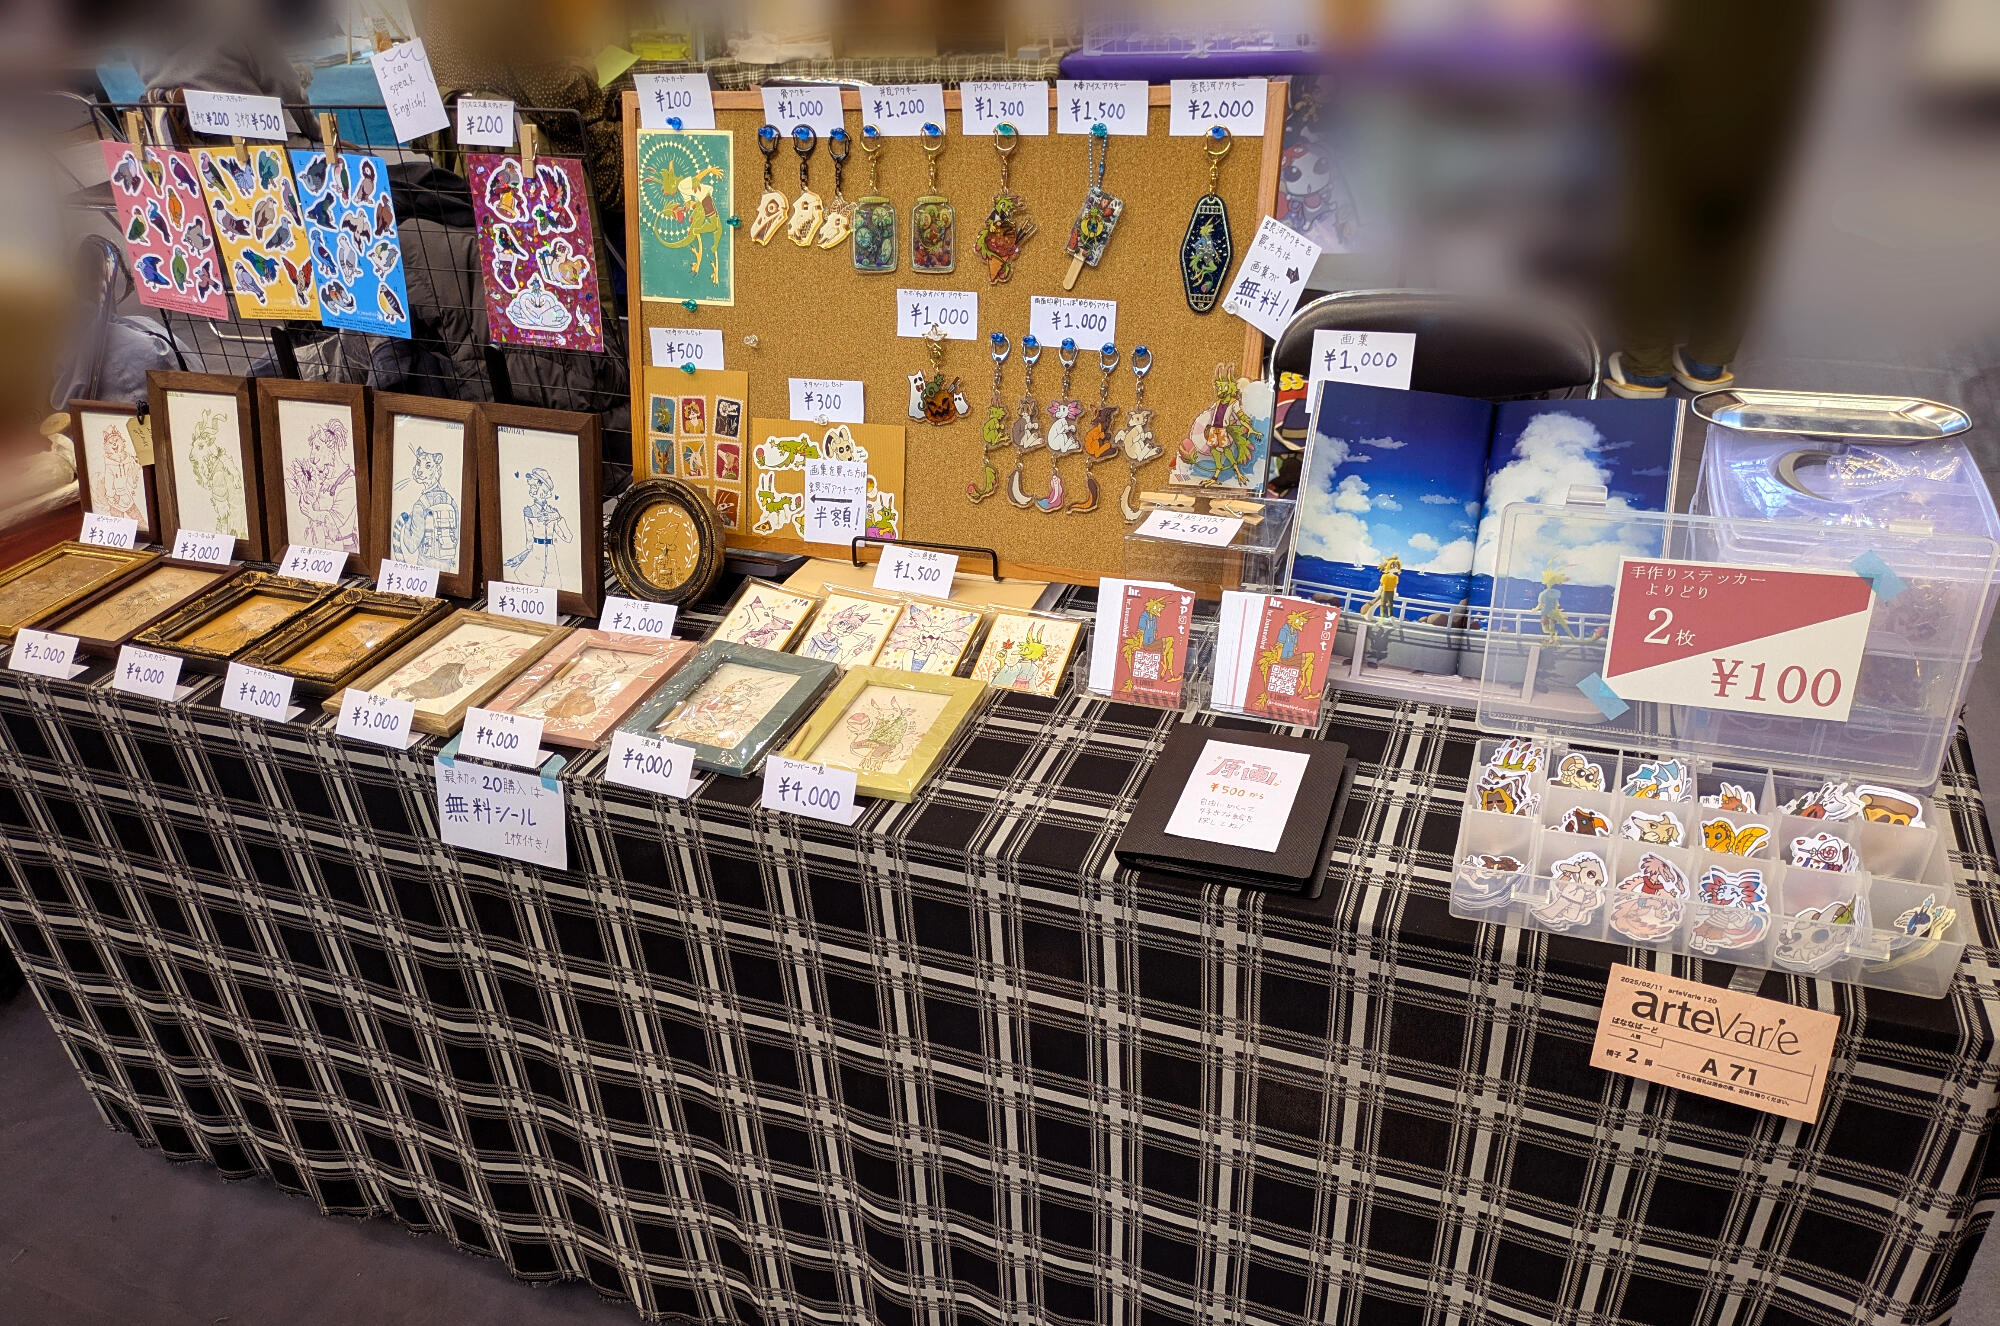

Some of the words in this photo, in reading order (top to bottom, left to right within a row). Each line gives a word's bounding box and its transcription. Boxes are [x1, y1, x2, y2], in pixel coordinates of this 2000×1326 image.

[380, 67, 388, 79] I
[393, 62, 409, 74] can
[390, 74, 416, 96] speak
[392, 92, 427, 117] English!
[655, 89, 692, 112] ¥100
[778, 100, 823, 119] ¥1,000
[874, 99, 925, 119] ¥1,200
[467, 115, 503, 135] ¥200
[1234, 277, 1290, 321] 無料!
[1340, 333, 1368, 346] 画集
[666, 342, 703, 362] ¥500
[1324, 349, 1398, 372] ¥1,000
[804, 391, 841, 410] ¥300
[1630, 565, 1767, 585] 手作りステッカー
[1644, 583, 1710, 600] よりどり
[1710, 657, 1842, 708] ¥100
[1206, 758, 1278, 785] 原画
[445, 793, 536, 826] 無料シール
[1620, 976, 1663, 991] 2025/02/11
[1668, 988, 1702, 1001] arteVarie
[1703, 996, 1718, 1004] 120
[1631, 989, 1802, 1056] arteVarie
[1625, 1048, 1639, 1064] 2
[1699, 1058, 1718, 1077] A
[1729, 1063, 1758, 1086] 71
